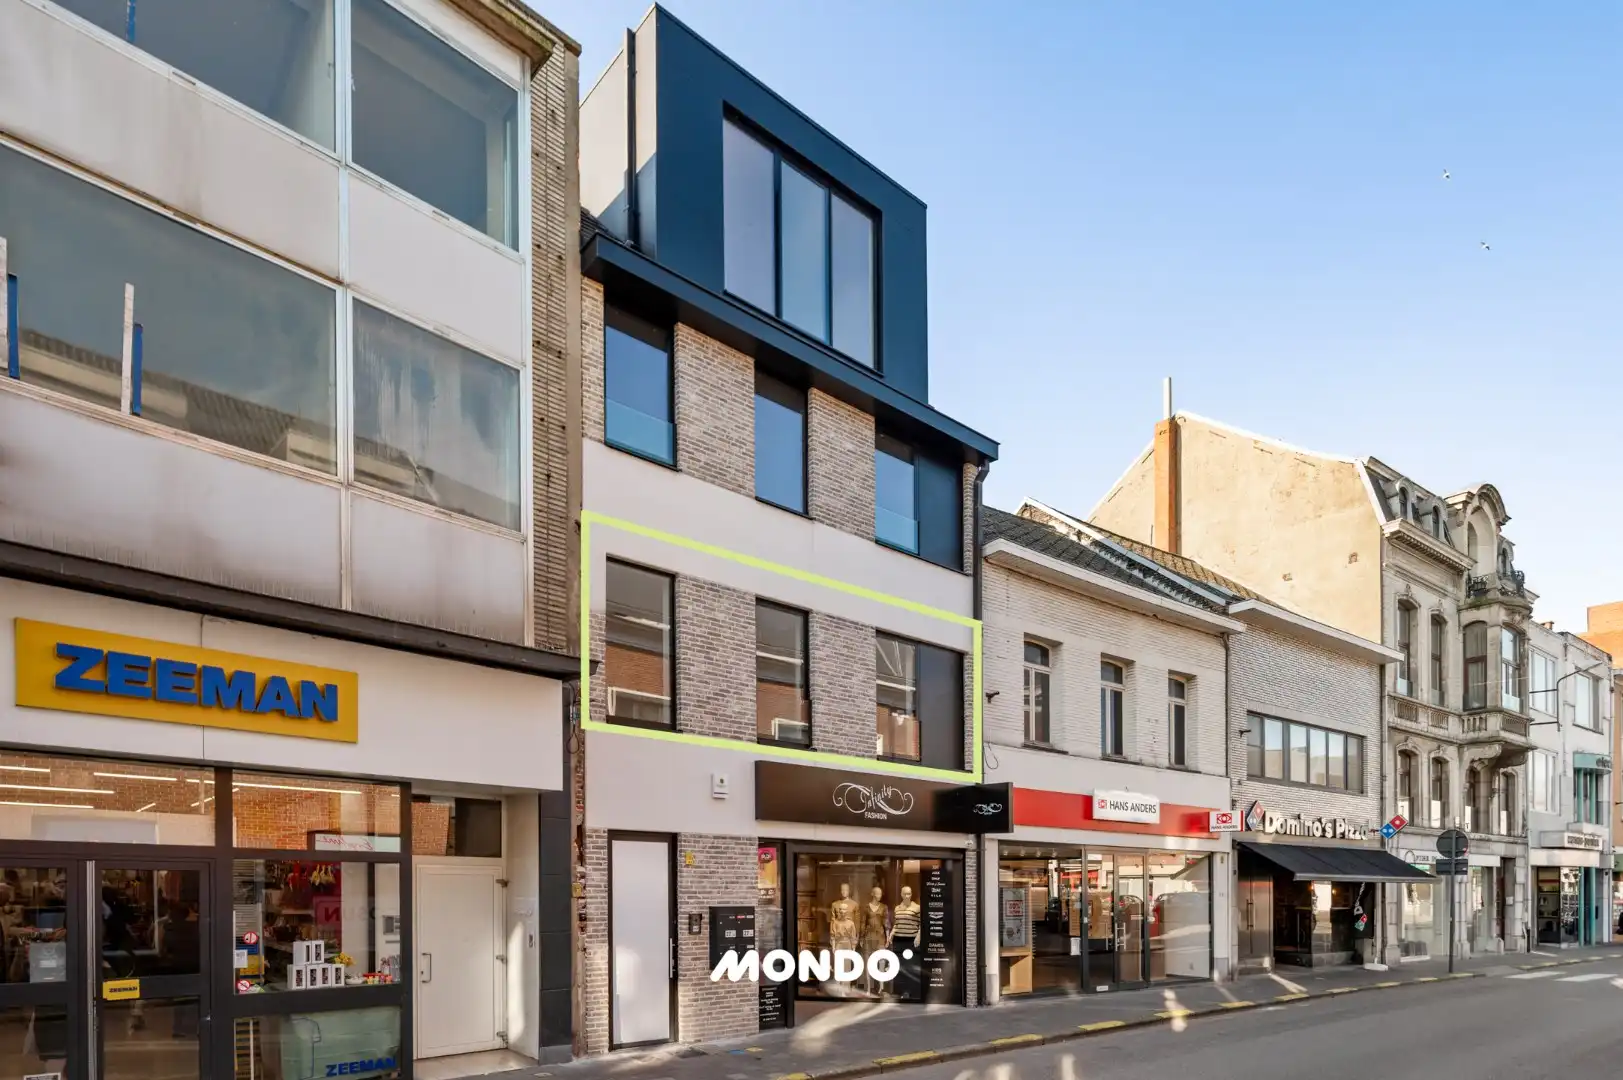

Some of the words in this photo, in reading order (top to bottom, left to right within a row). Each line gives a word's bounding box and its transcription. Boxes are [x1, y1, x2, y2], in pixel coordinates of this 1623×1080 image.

[54, 642, 339, 722] ZEEMAN
[864, 811, 888, 820] FASHION
[1109, 800, 1129, 812] HANS
[1130, 802, 1157, 815] ANDERS
[1265, 811, 1333, 838] Domino's
[1335, 818, 1369, 840] Pizza
[325, 1056, 396, 1077] ZEEMAN
